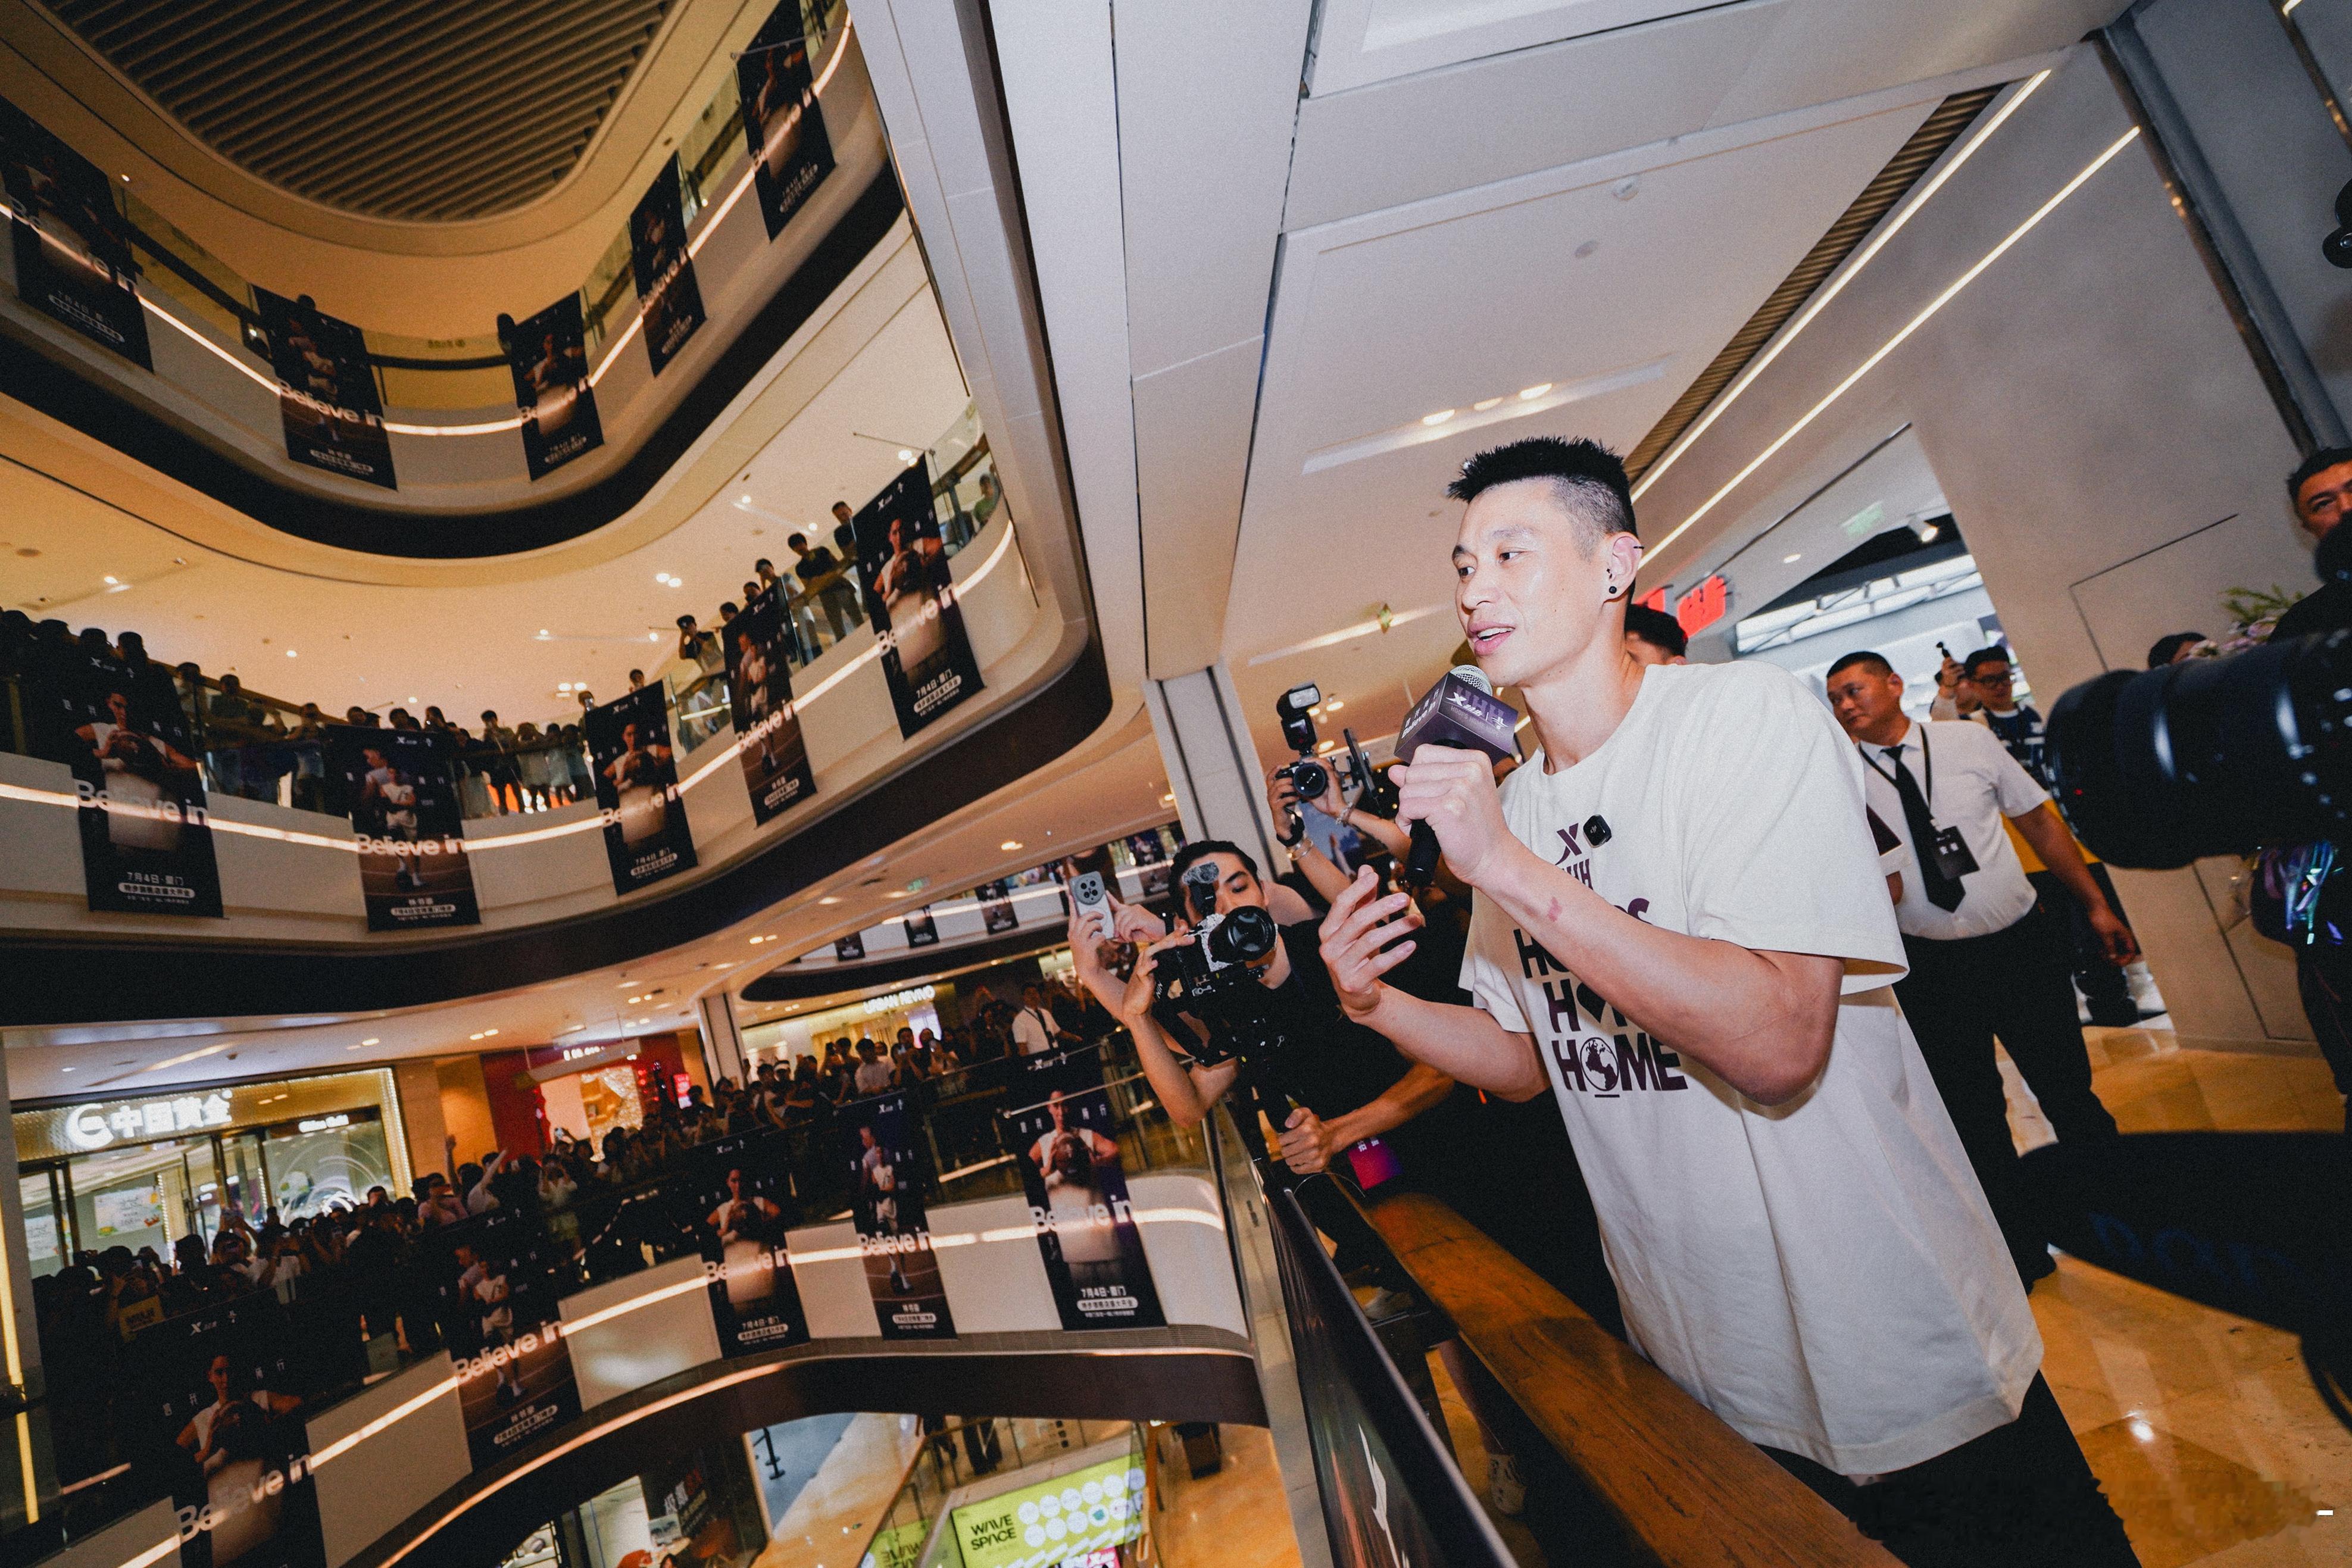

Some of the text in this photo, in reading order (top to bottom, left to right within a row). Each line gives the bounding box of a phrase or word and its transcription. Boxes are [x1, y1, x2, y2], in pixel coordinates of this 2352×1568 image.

[185, 798, 210, 825] in
[354, 833, 466, 856] Believe in
[1110, 1195, 1133, 1223] in
[453, 1320, 563, 1383] Believe in
[288, 1454, 314, 1484] in
